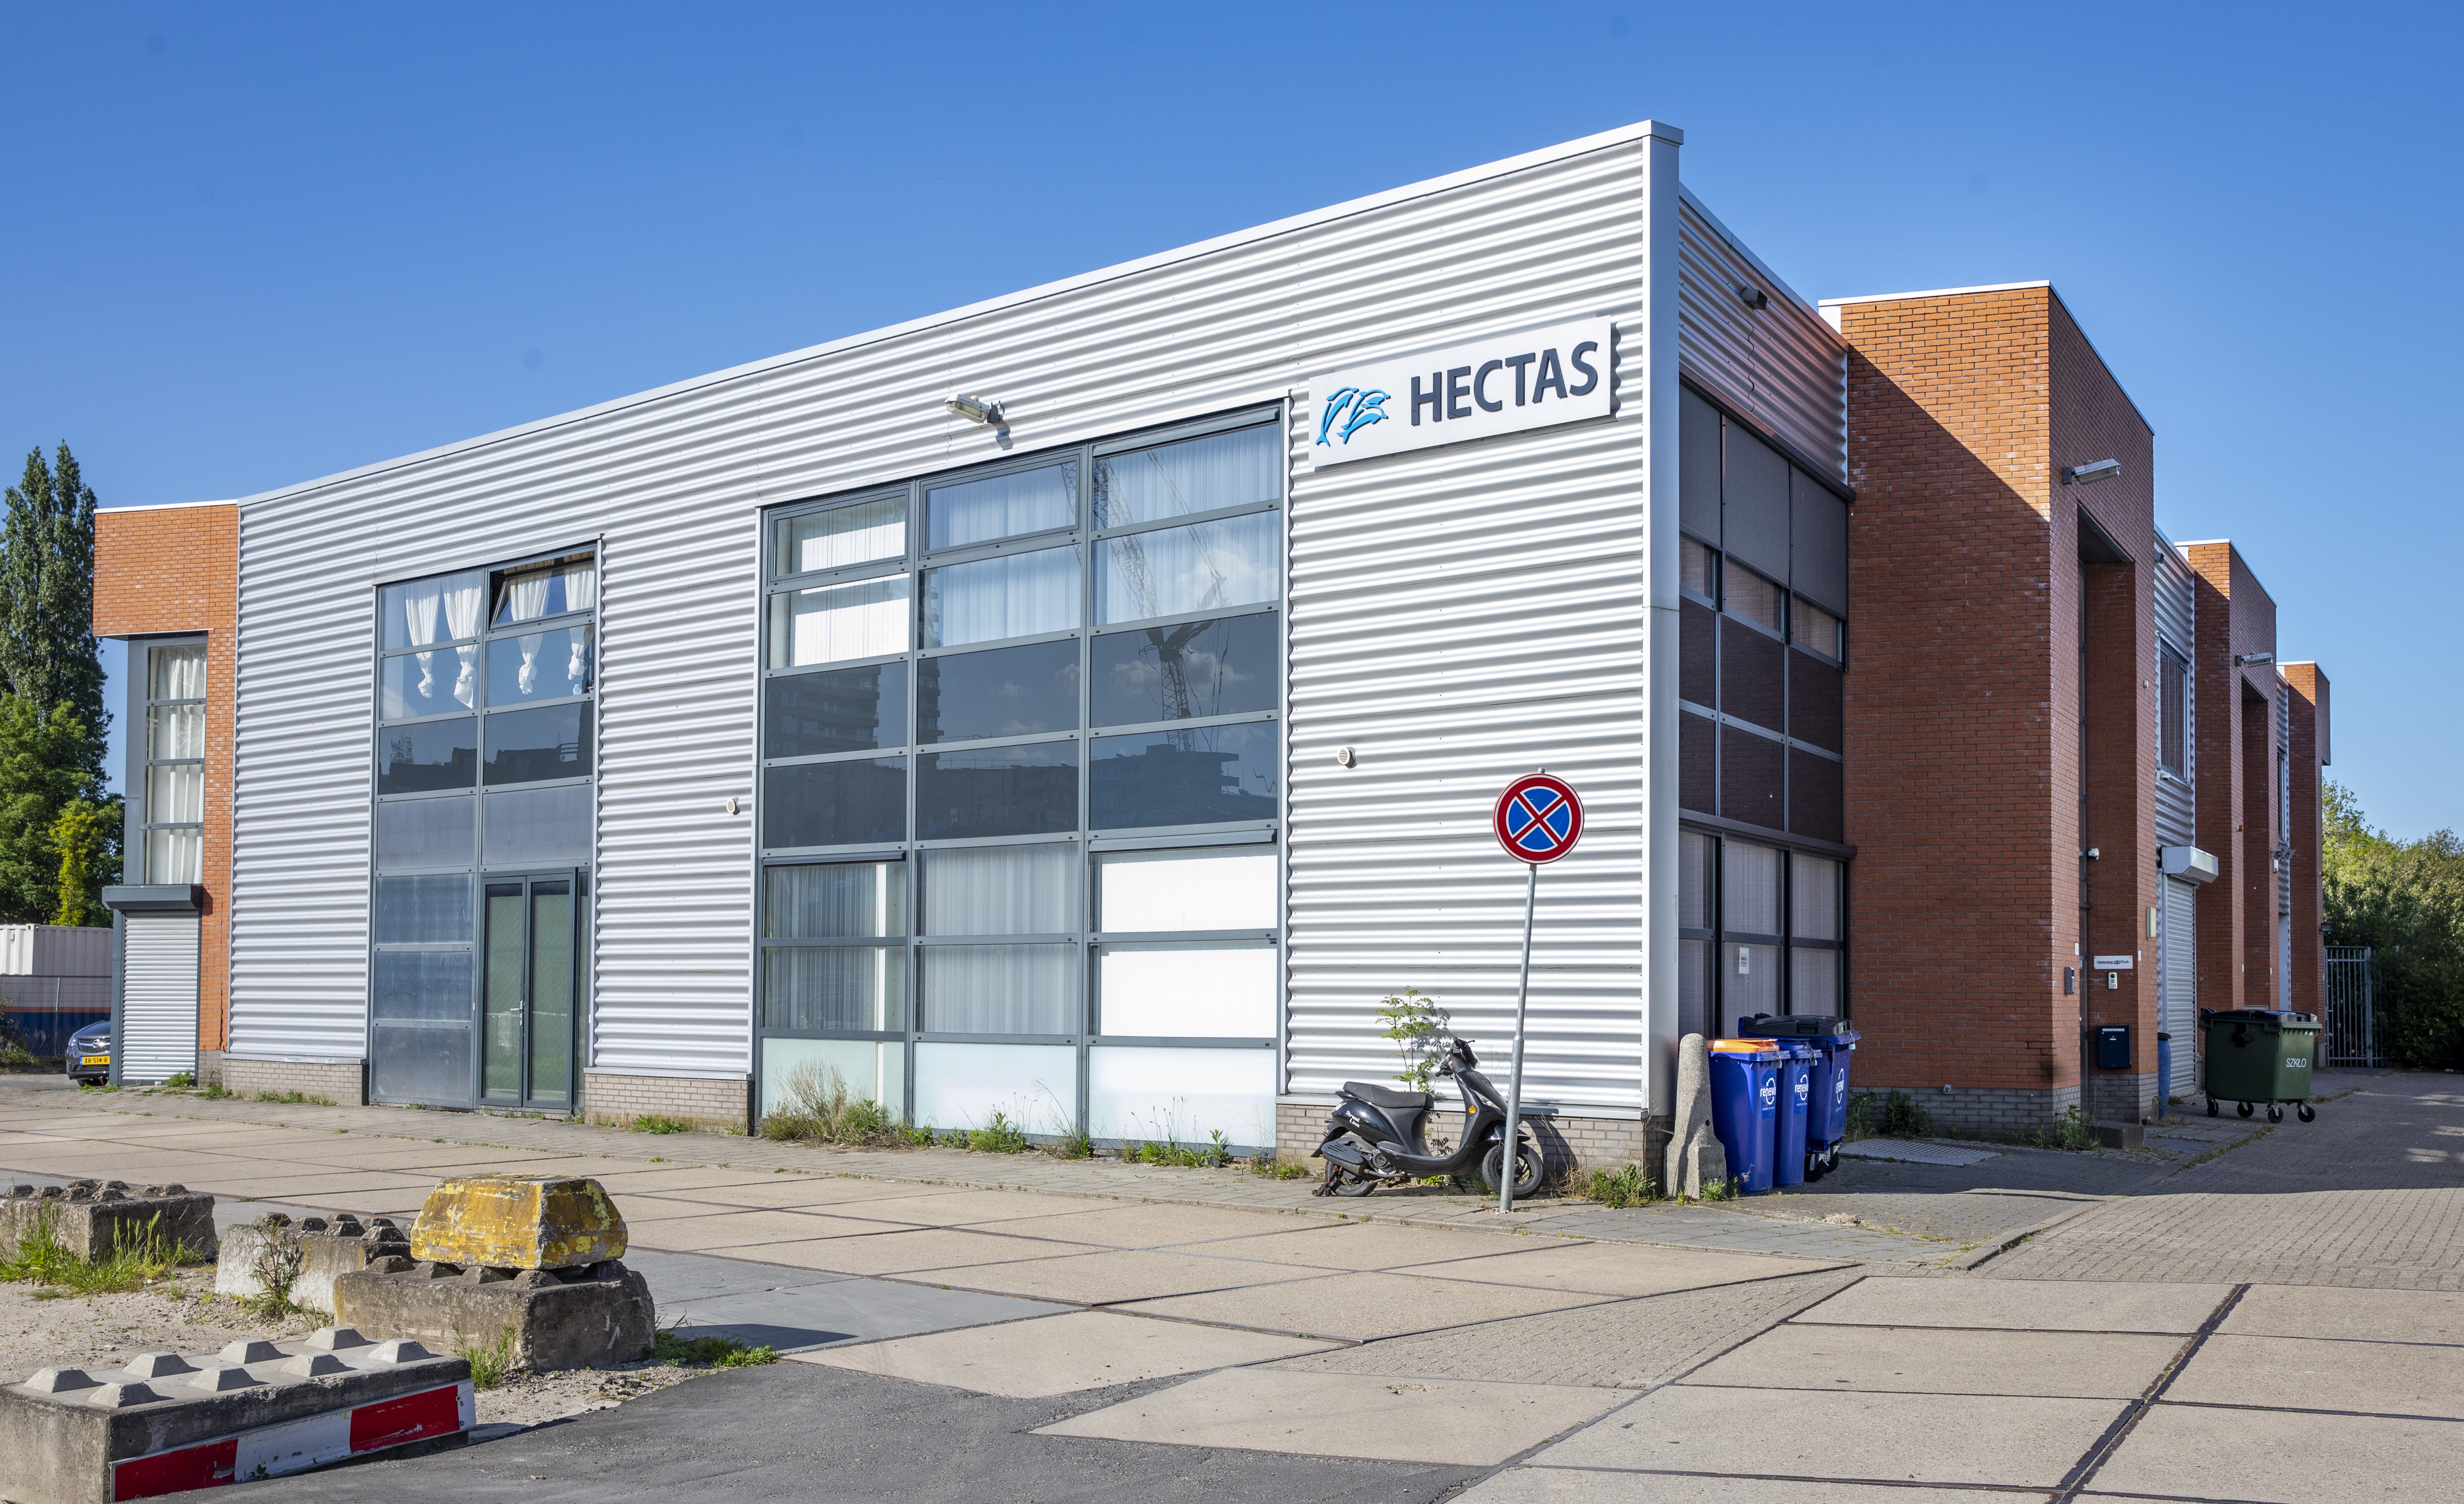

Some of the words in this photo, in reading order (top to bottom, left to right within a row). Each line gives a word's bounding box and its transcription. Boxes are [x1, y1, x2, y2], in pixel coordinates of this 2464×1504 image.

[1411, 341, 1598, 426] HECTAS
[2286, 1058, 2307, 1068] SZKŁO
[1346, 1110, 1360, 1122] Street
[1349, 1118, 1360, 1128] Line
